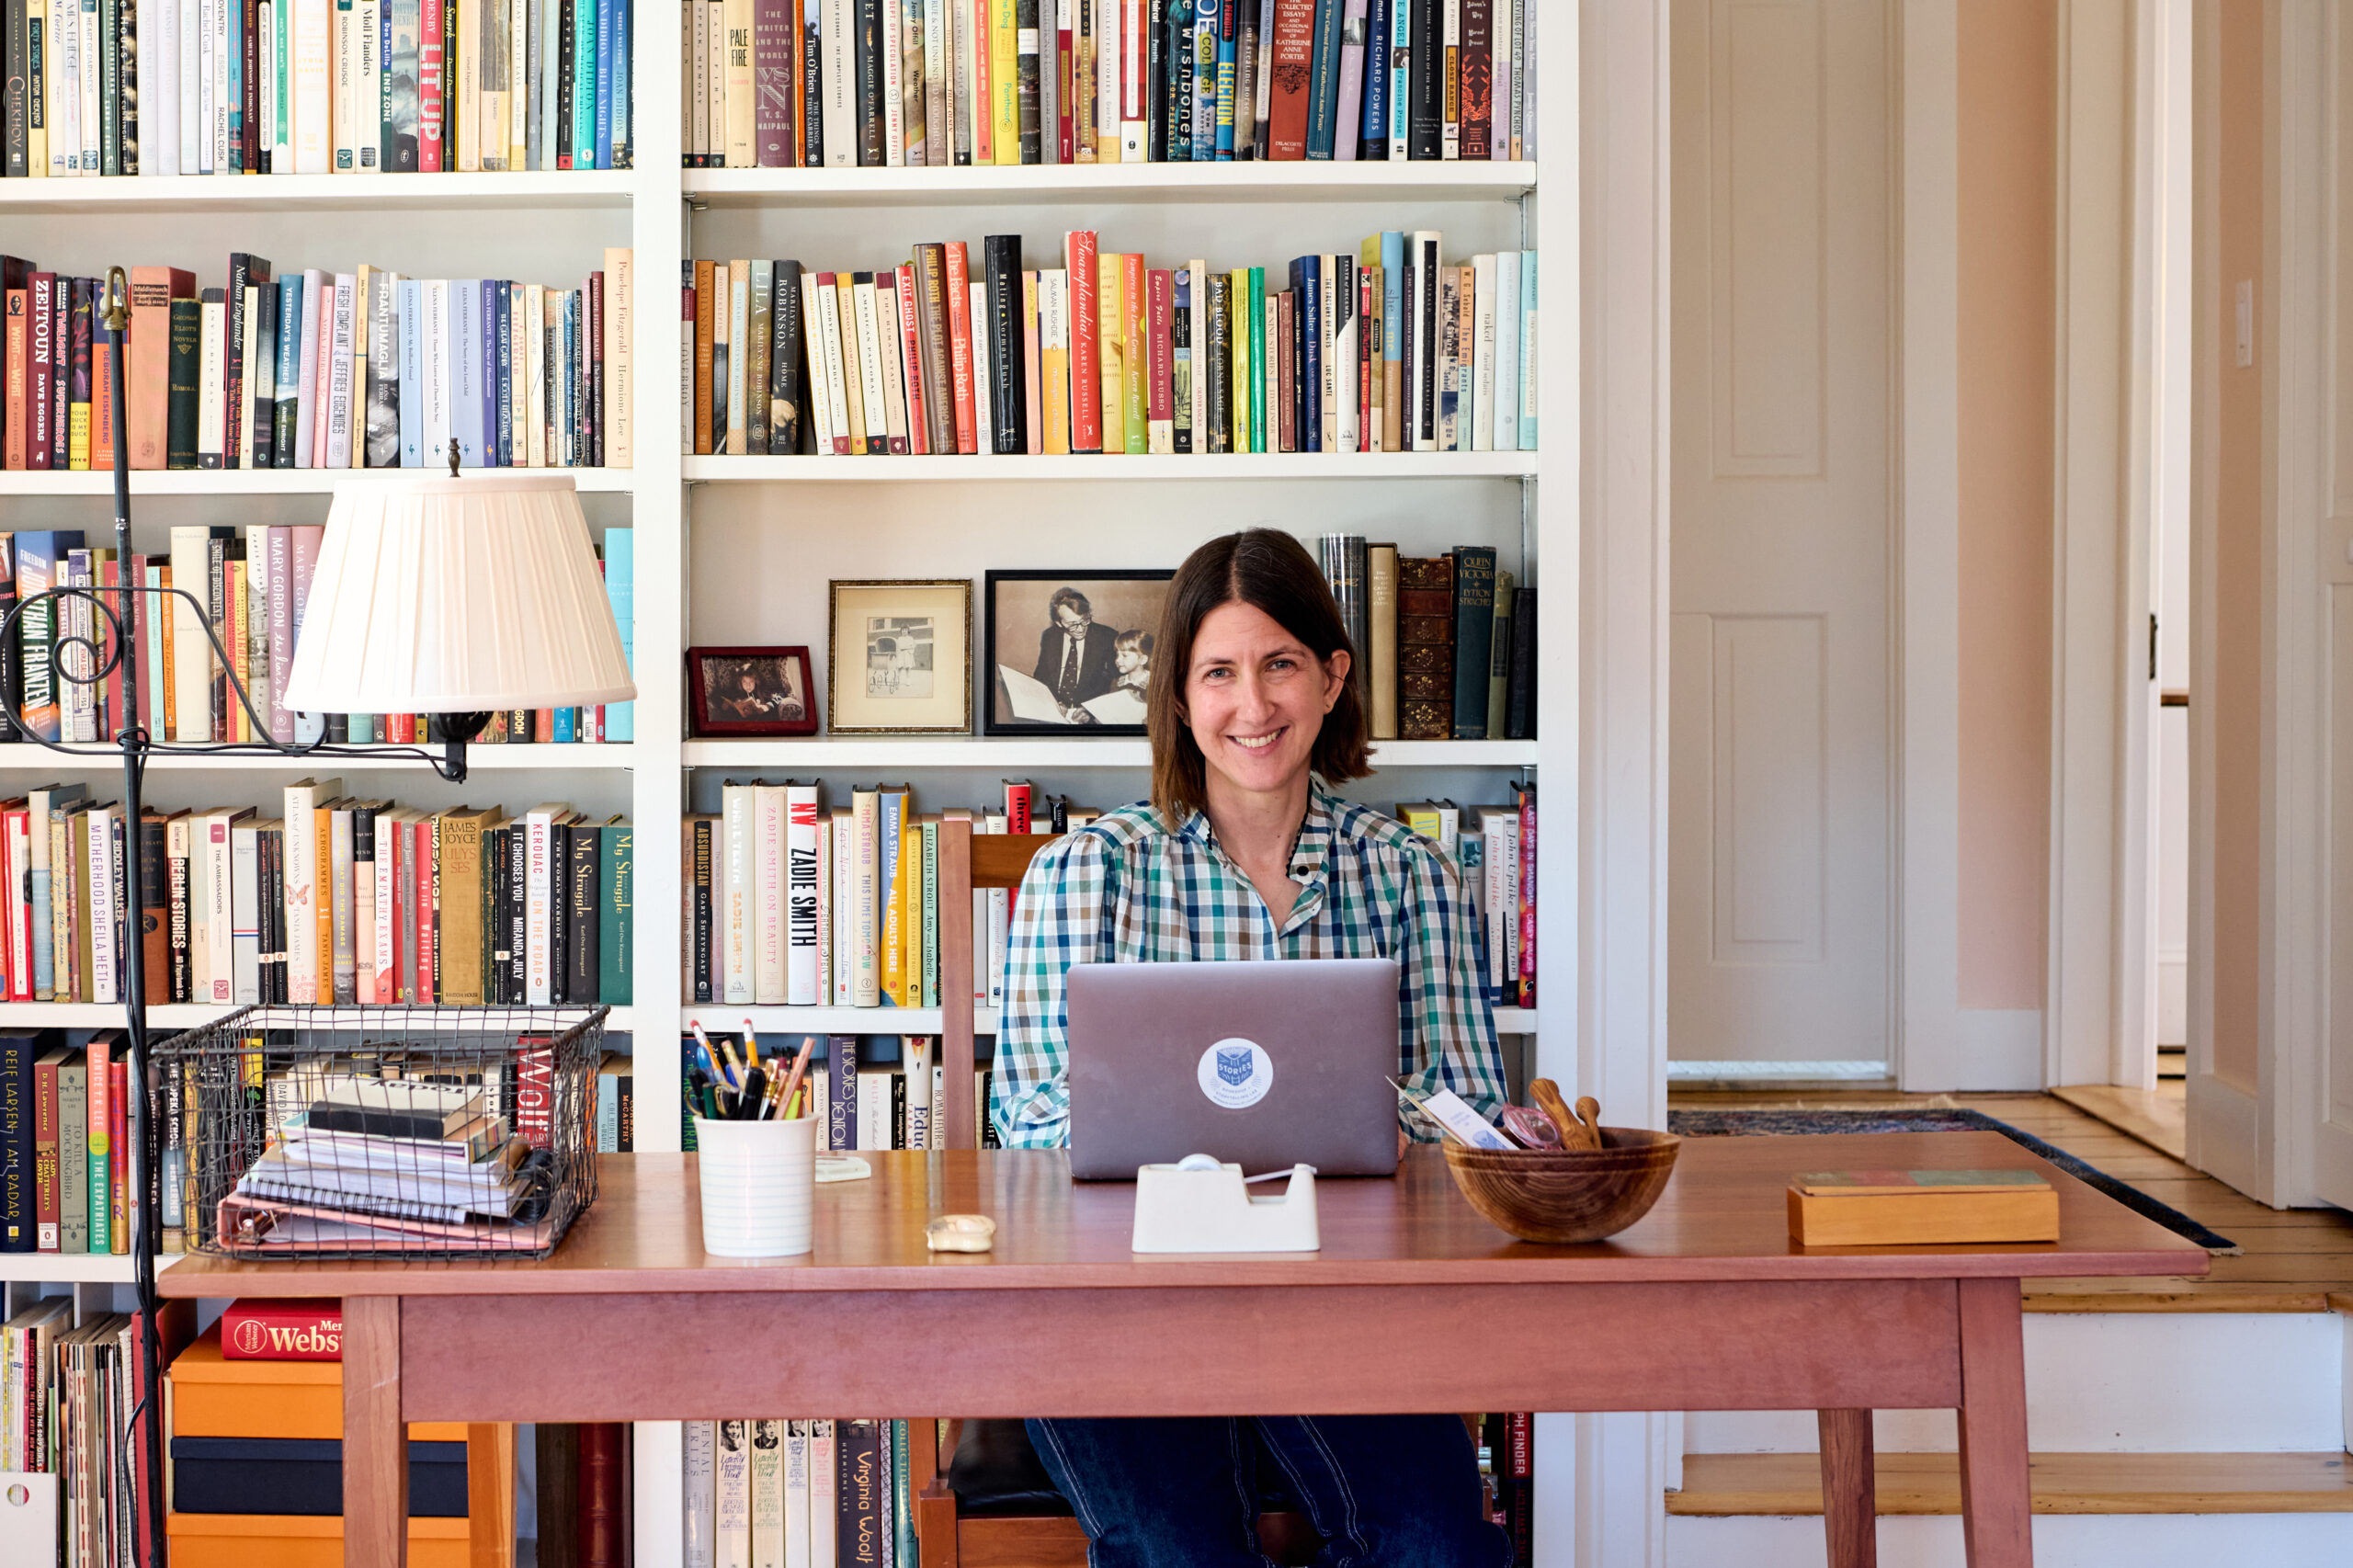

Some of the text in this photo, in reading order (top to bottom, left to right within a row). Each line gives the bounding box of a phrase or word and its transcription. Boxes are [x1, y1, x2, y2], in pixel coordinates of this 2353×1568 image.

[32, 23, 41, 42] FORTY
[364, 8, 373, 76] Moll Flanders
[731, 29, 748, 47] PALE
[1223, 5, 1233, 37] PERROTTA
[32, 44, 41, 69] STORIES
[383, 73, 392, 92] END
[586, 20, 595, 110] JOAN DIDION
[732, 50, 747, 66] FIRE
[807, 38, 818, 93] Tim O'Brien
[1181, 28, 1192, 146] Wishbones
[1200, 37, 1211, 94] COLLEGE
[1371, 35, 1383, 131] RICHARD POWERS
[8, 76, 25, 147] CHEKHOV
[383, 95, 392, 122] ZONE
[421, 44, 441, 141] LIT UP
[598, 67, 608, 139] BLUE NIGHTS
[757, 122, 790, 131] NAIPAUL
[1216, 62, 1234, 125] ELECTION
[1514, 67, 1522, 135] THOMAS PYNCHON
[233, 265, 245, 350] Nathan Englander
[755, 271, 768, 315] LILA
[902, 276, 915, 332] EXIT GHOST
[926, 248, 940, 302] PHILIP ROTH
[1074, 233, 1094, 340] Swamplandia!
[35, 280, 49, 364] ZEITOUN
[284, 287, 292, 342] YESTERDAY'S
[378, 283, 389, 380] FRANTUMAGLIA
[777, 279, 788, 349] ROBINSON
[949, 251, 969, 401] The Facts Philip Roth
[1215, 281, 1223, 344] BAD BLOOD
[1307, 278, 1317, 363] James Salter Dusk
[1387, 289, 1398, 352] she is me
[1483, 313, 1493, 342] naked
[56, 311, 66, 453] TWILIGHT SUPERHEROES
[281, 345, 290, 383] WEATHER
[332, 286, 350, 434] FRESH COMPLAINT JEFFREY EUGENIDES
[617, 261, 627, 436] Penelope Fitzgerald Hermione Lee
[272, 537, 285, 627] MARY GORDON
[23, 645, 50, 711] FRANZEN
[444, 824, 476, 832] JAMES
[444, 834, 476, 844] JOYCE
[1017, 797, 1027, 833] three
[113, 839, 125, 922] RIDDLEY WALKER
[574, 837, 593, 917] My Struggle
[614, 835, 631, 914] My Struggle
[697, 828, 710, 886] ABSURDISTAN
[790, 802, 816, 947] NW ZADIE SMITH
[926, 828, 934, 874] ELIZABETH
[1506, 831, 1517, 907] John Updike
[1527, 863, 1535, 906] SHANGHAI
[91, 824, 108, 981] MOTHERHOOD SHEILA HETI
[171, 858, 187, 949] BERLIN STORIES
[512, 833, 524, 980] IT CHOOSES YOU MIRANDA JULY
[533, 824, 543, 973] KEROUAC ON THE ROAD
[889, 807, 897, 972] EMMA STRAUB ALL ADULTS HERE
[1218, 1062, 1252, 1075] STORIES
[6, 1050, 19, 1217] REIF LARSEN AM RADAR
[832, 1101, 846, 1146] DENTON
[63, 1124, 73, 1199] MOCKINGBIRD
[95, 1182, 105, 1244] EXPATRIATES
[1515, 1431, 1526, 1473] FINDER
[853, 1451, 874, 1563] Virginia Woolf
